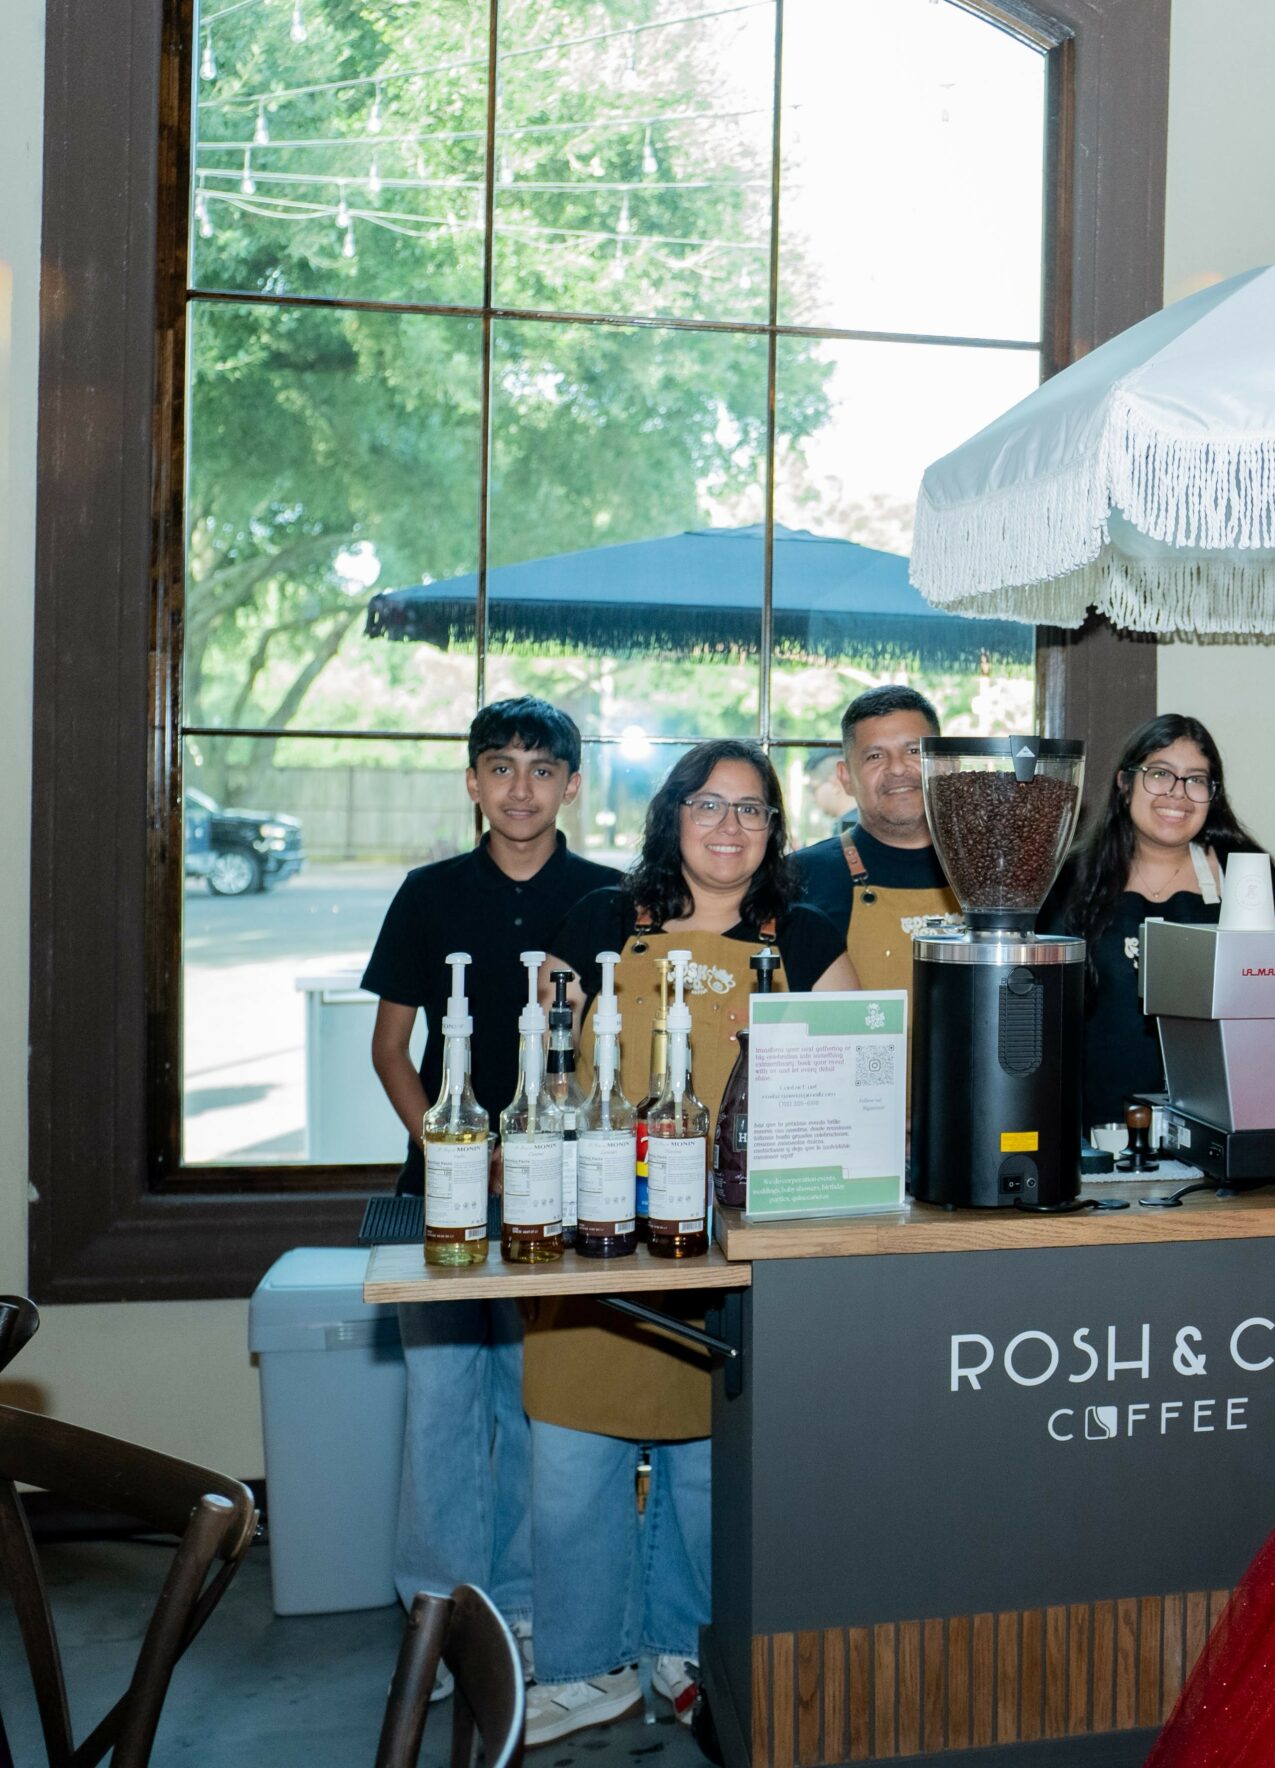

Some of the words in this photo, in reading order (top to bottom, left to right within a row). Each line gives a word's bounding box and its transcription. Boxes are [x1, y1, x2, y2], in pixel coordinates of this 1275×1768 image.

[949, 1323, 1150, 1392] ROSH
[1172, 1325, 1207, 1376] &
[1047, 1397, 1249, 1441] COFFEE
